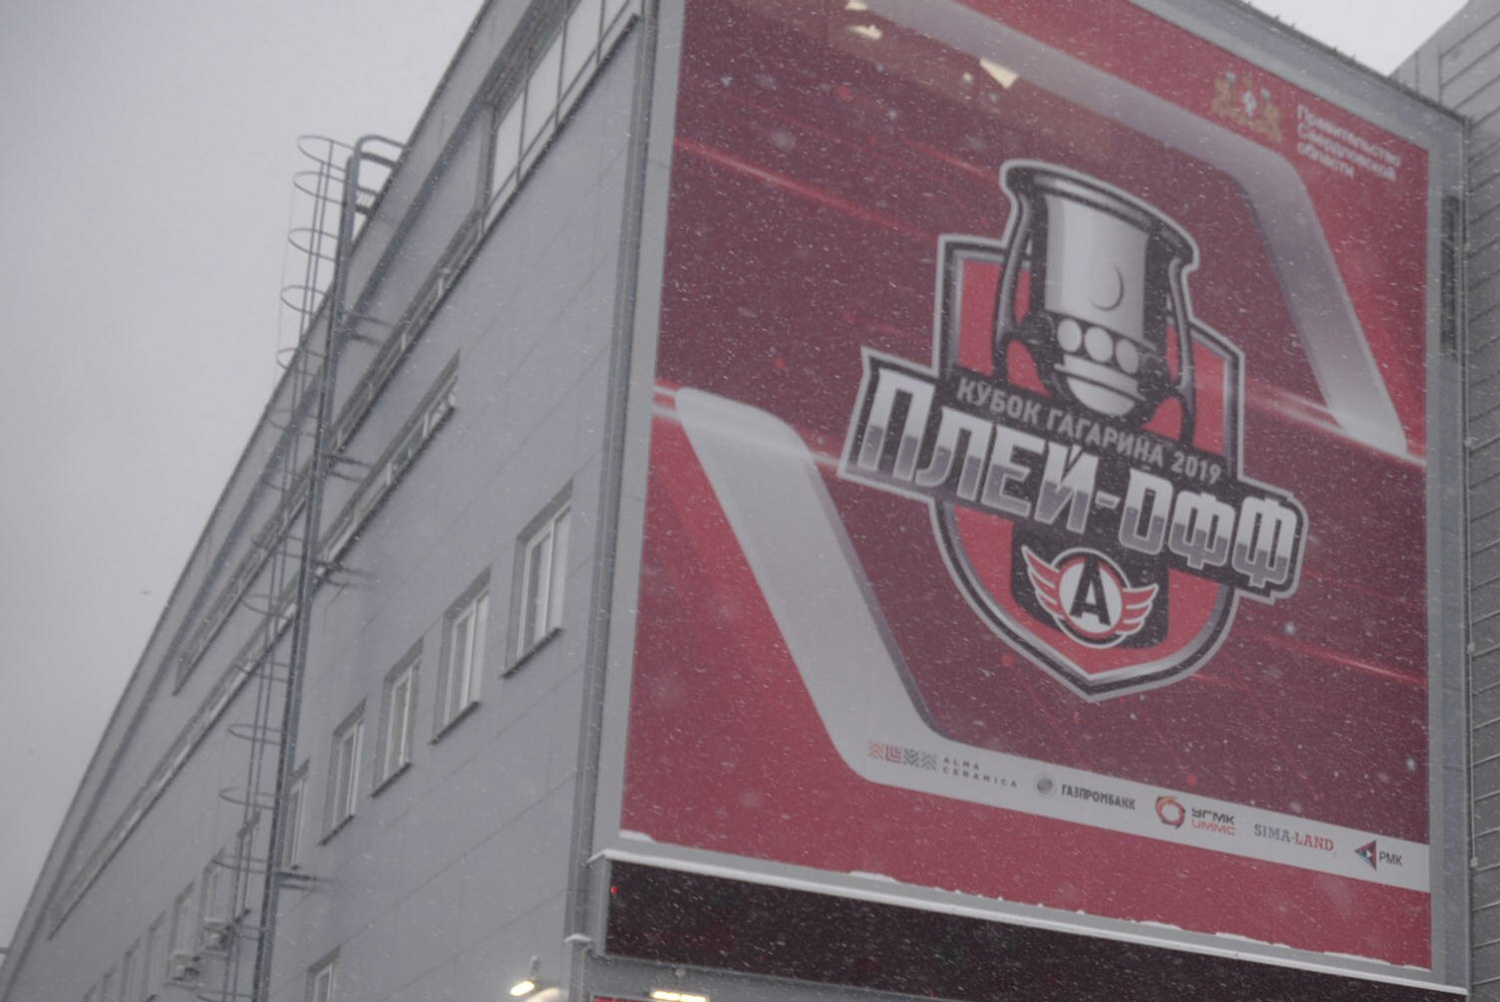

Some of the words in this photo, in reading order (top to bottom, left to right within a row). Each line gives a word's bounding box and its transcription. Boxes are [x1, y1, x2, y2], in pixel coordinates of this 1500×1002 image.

[957, 377, 1042, 425] КУБОК
[1047, 408, 1163, 468] ГАГАРИНА
[1171, 451, 1221, 485] 2019
[856, 367, 1299, 588] ПЛЕЙ-ОФФ
[1061, 783, 1136, 811] ГАЗПРОМБАНК
[1191, 806, 1235, 825] УГМК
[1254, 823, 1335, 852] SIMA-LAND
